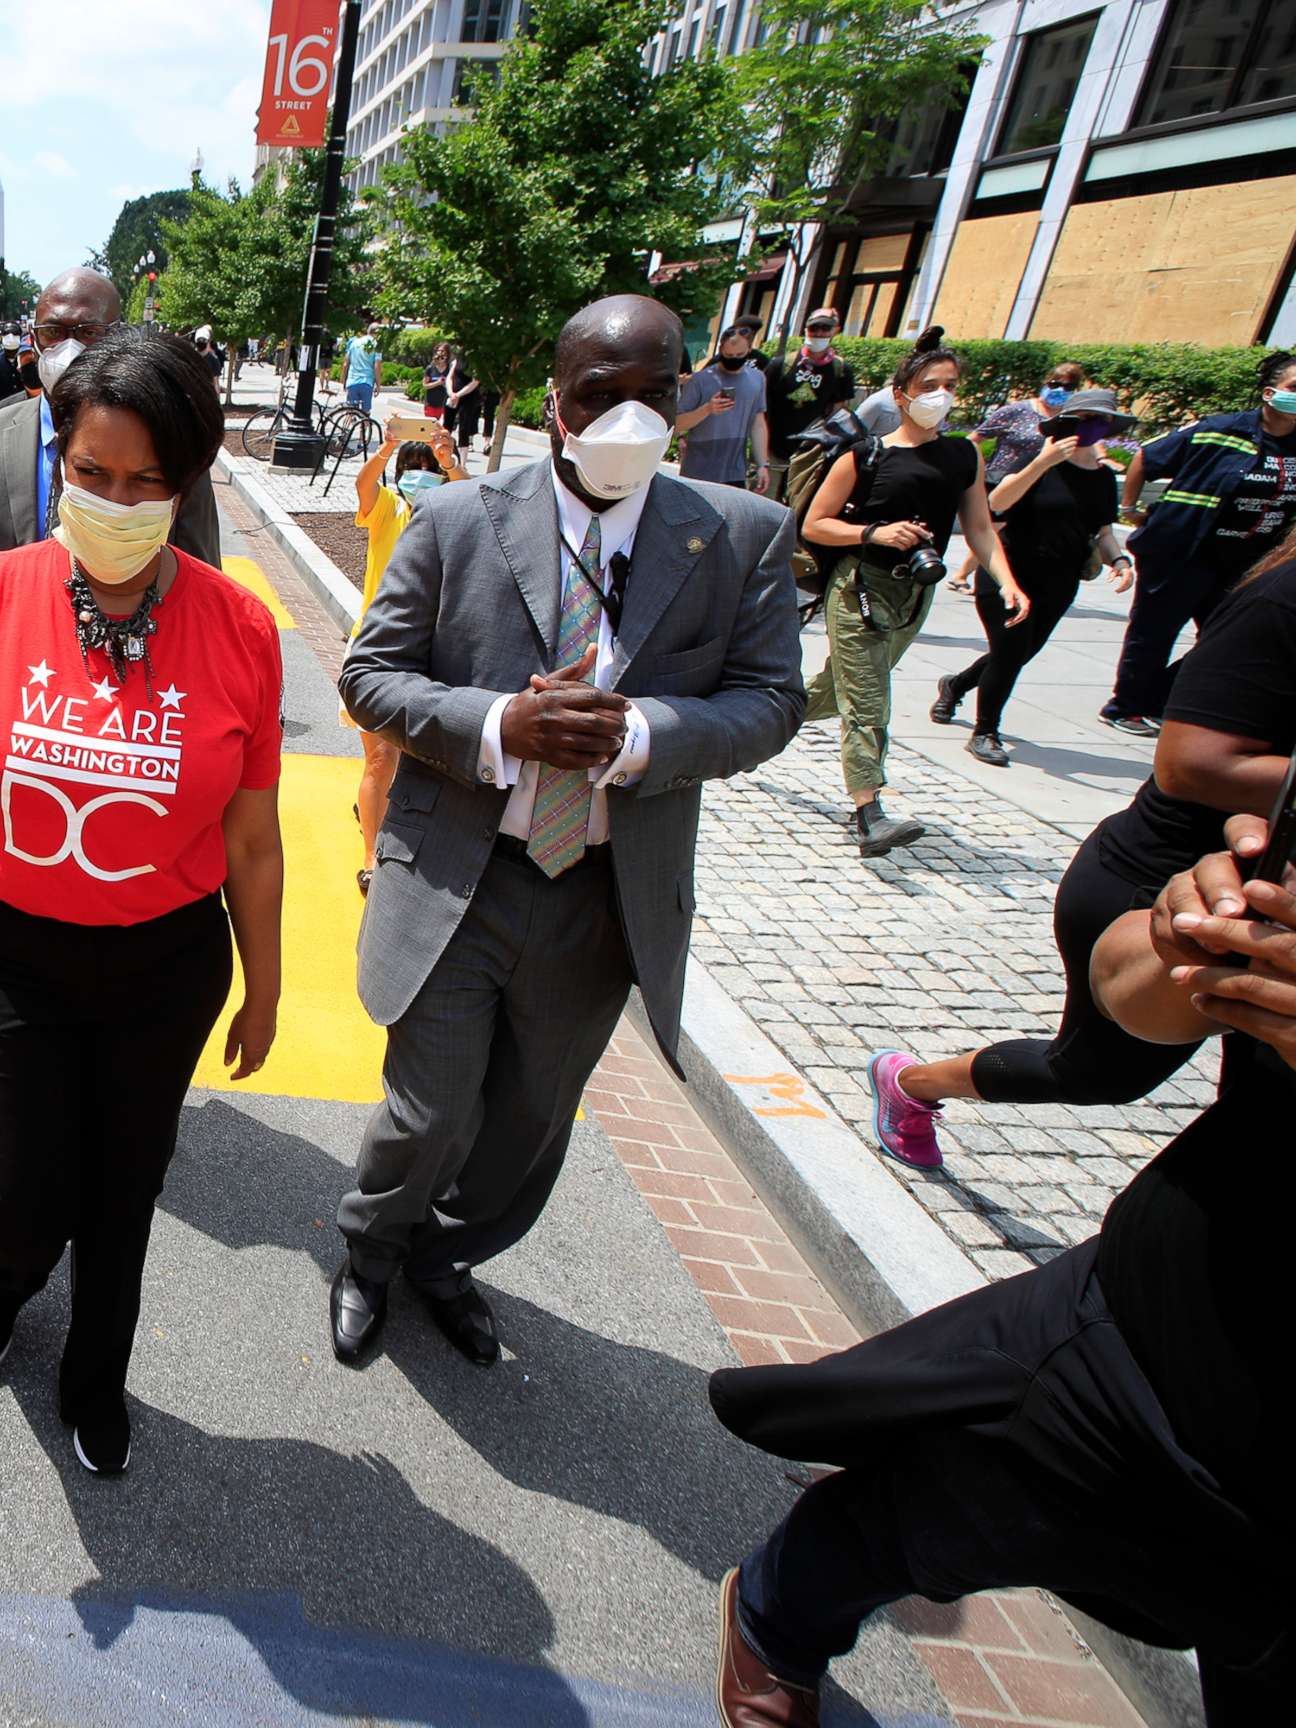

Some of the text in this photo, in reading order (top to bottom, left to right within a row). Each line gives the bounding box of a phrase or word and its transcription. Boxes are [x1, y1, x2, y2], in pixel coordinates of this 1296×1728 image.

[275, 100, 312, 110] STREET
[21, 686, 186, 747] WE ARE
[10, 735, 180, 781] WASHINGTON
[1, 769, 169, 882] DC
